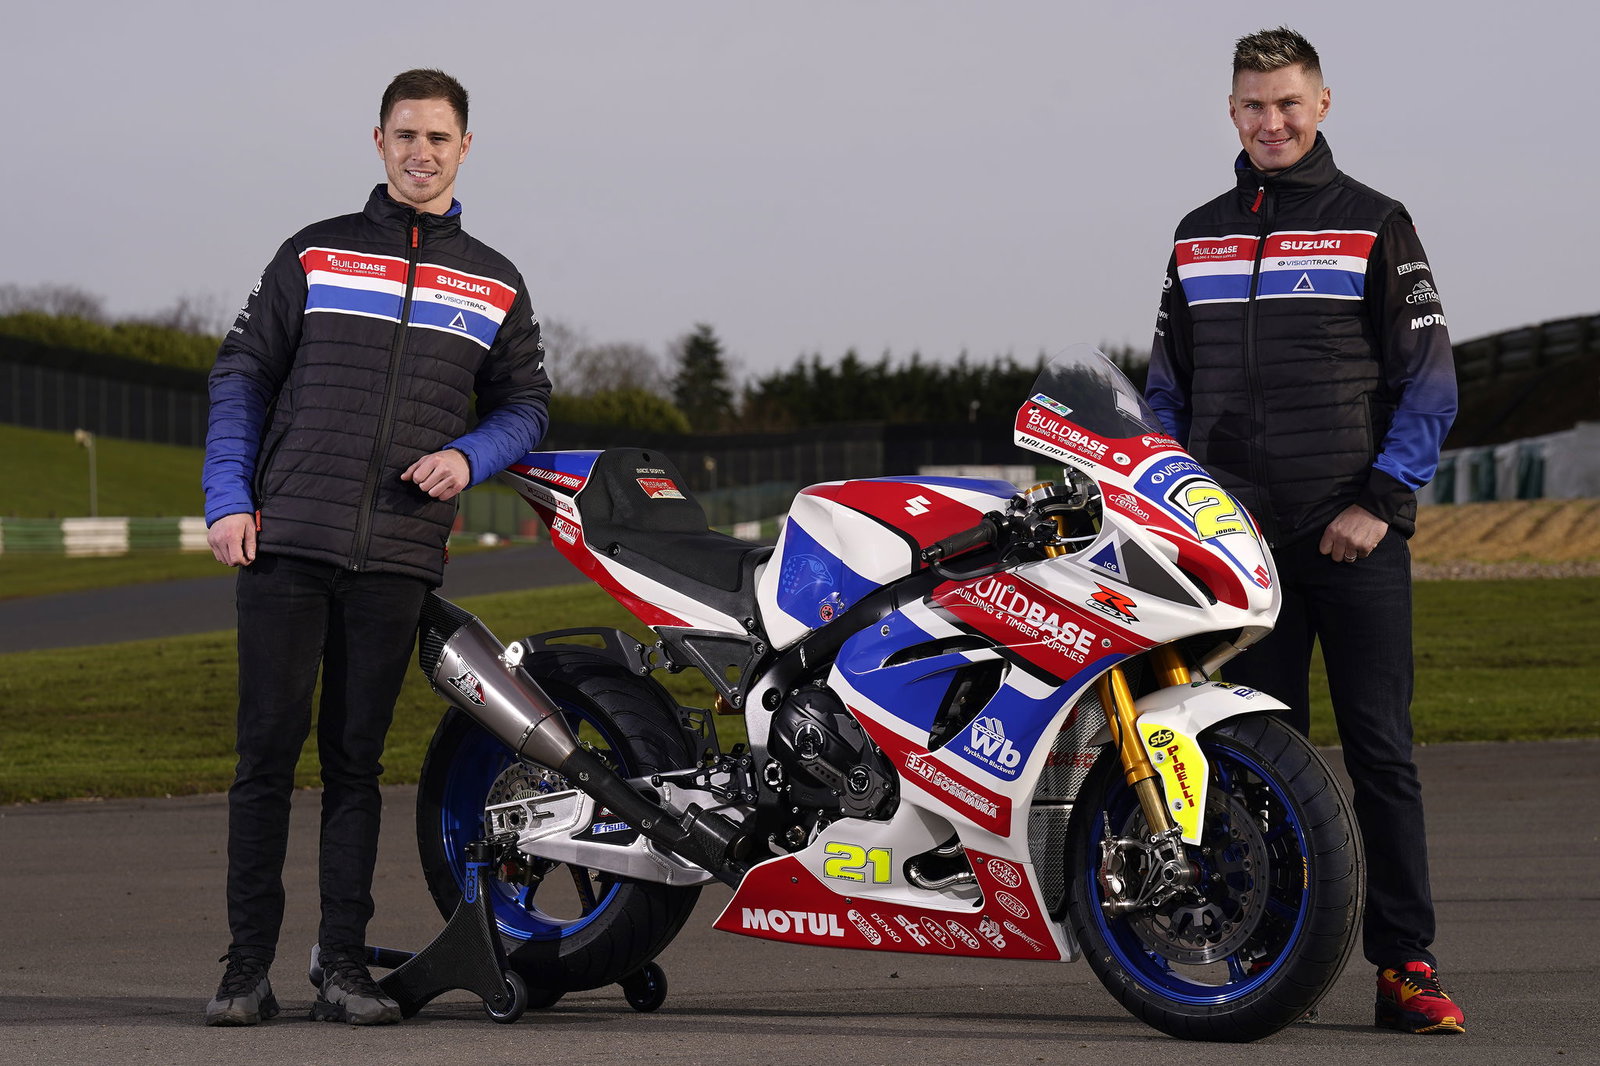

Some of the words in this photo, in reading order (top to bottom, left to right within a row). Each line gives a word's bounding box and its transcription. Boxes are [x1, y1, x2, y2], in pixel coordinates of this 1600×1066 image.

[1193, 245, 1238, 256] BUILDBASE
[1280, 240, 1341, 250] SUZUKI
[331, 259, 387, 273] BUILDBASE
[436, 275, 491, 296] SUZUKI
[443, 294, 487, 311] VISIONTRACK
[1411, 313, 1447, 330] MOTU
[1025, 422, 1051, 438] BUILDING
[1057, 436, 1077, 449] TIMBER
[1077, 445, 1103, 461] SUPPLIES
[1028, 412, 1109, 456] BUILDBASE
[1018, 435, 1068, 457] MALLORY
[1067, 454, 1097, 468] PARK
[527, 467, 562, 482] MALLORY
[559, 475, 582, 488] PARK
[1108, 494, 1150, 520] Crendon
[1185, 486, 1247, 541] 2
[995, 611, 1003, 620] &
[1005, 615, 1040, 640] TIMBER
[1041, 635, 1087, 665] SUPPLIES
[1149, 730, 1173, 748] sbs
[963, 744, 989, 764] Wyckham
[988, 760, 1016, 776] Blackwell
[1166, 744, 1195, 808] PIRELLI
[932, 773, 998, 819] YOSHIMURA
[824, 841, 892, 884] 21
[991, 860, 1018, 882] IMAGE
[742, 907, 845, 937] MOTUL
[870, 913, 902, 943] DENSO
[948, 921, 979, 948] BMC
